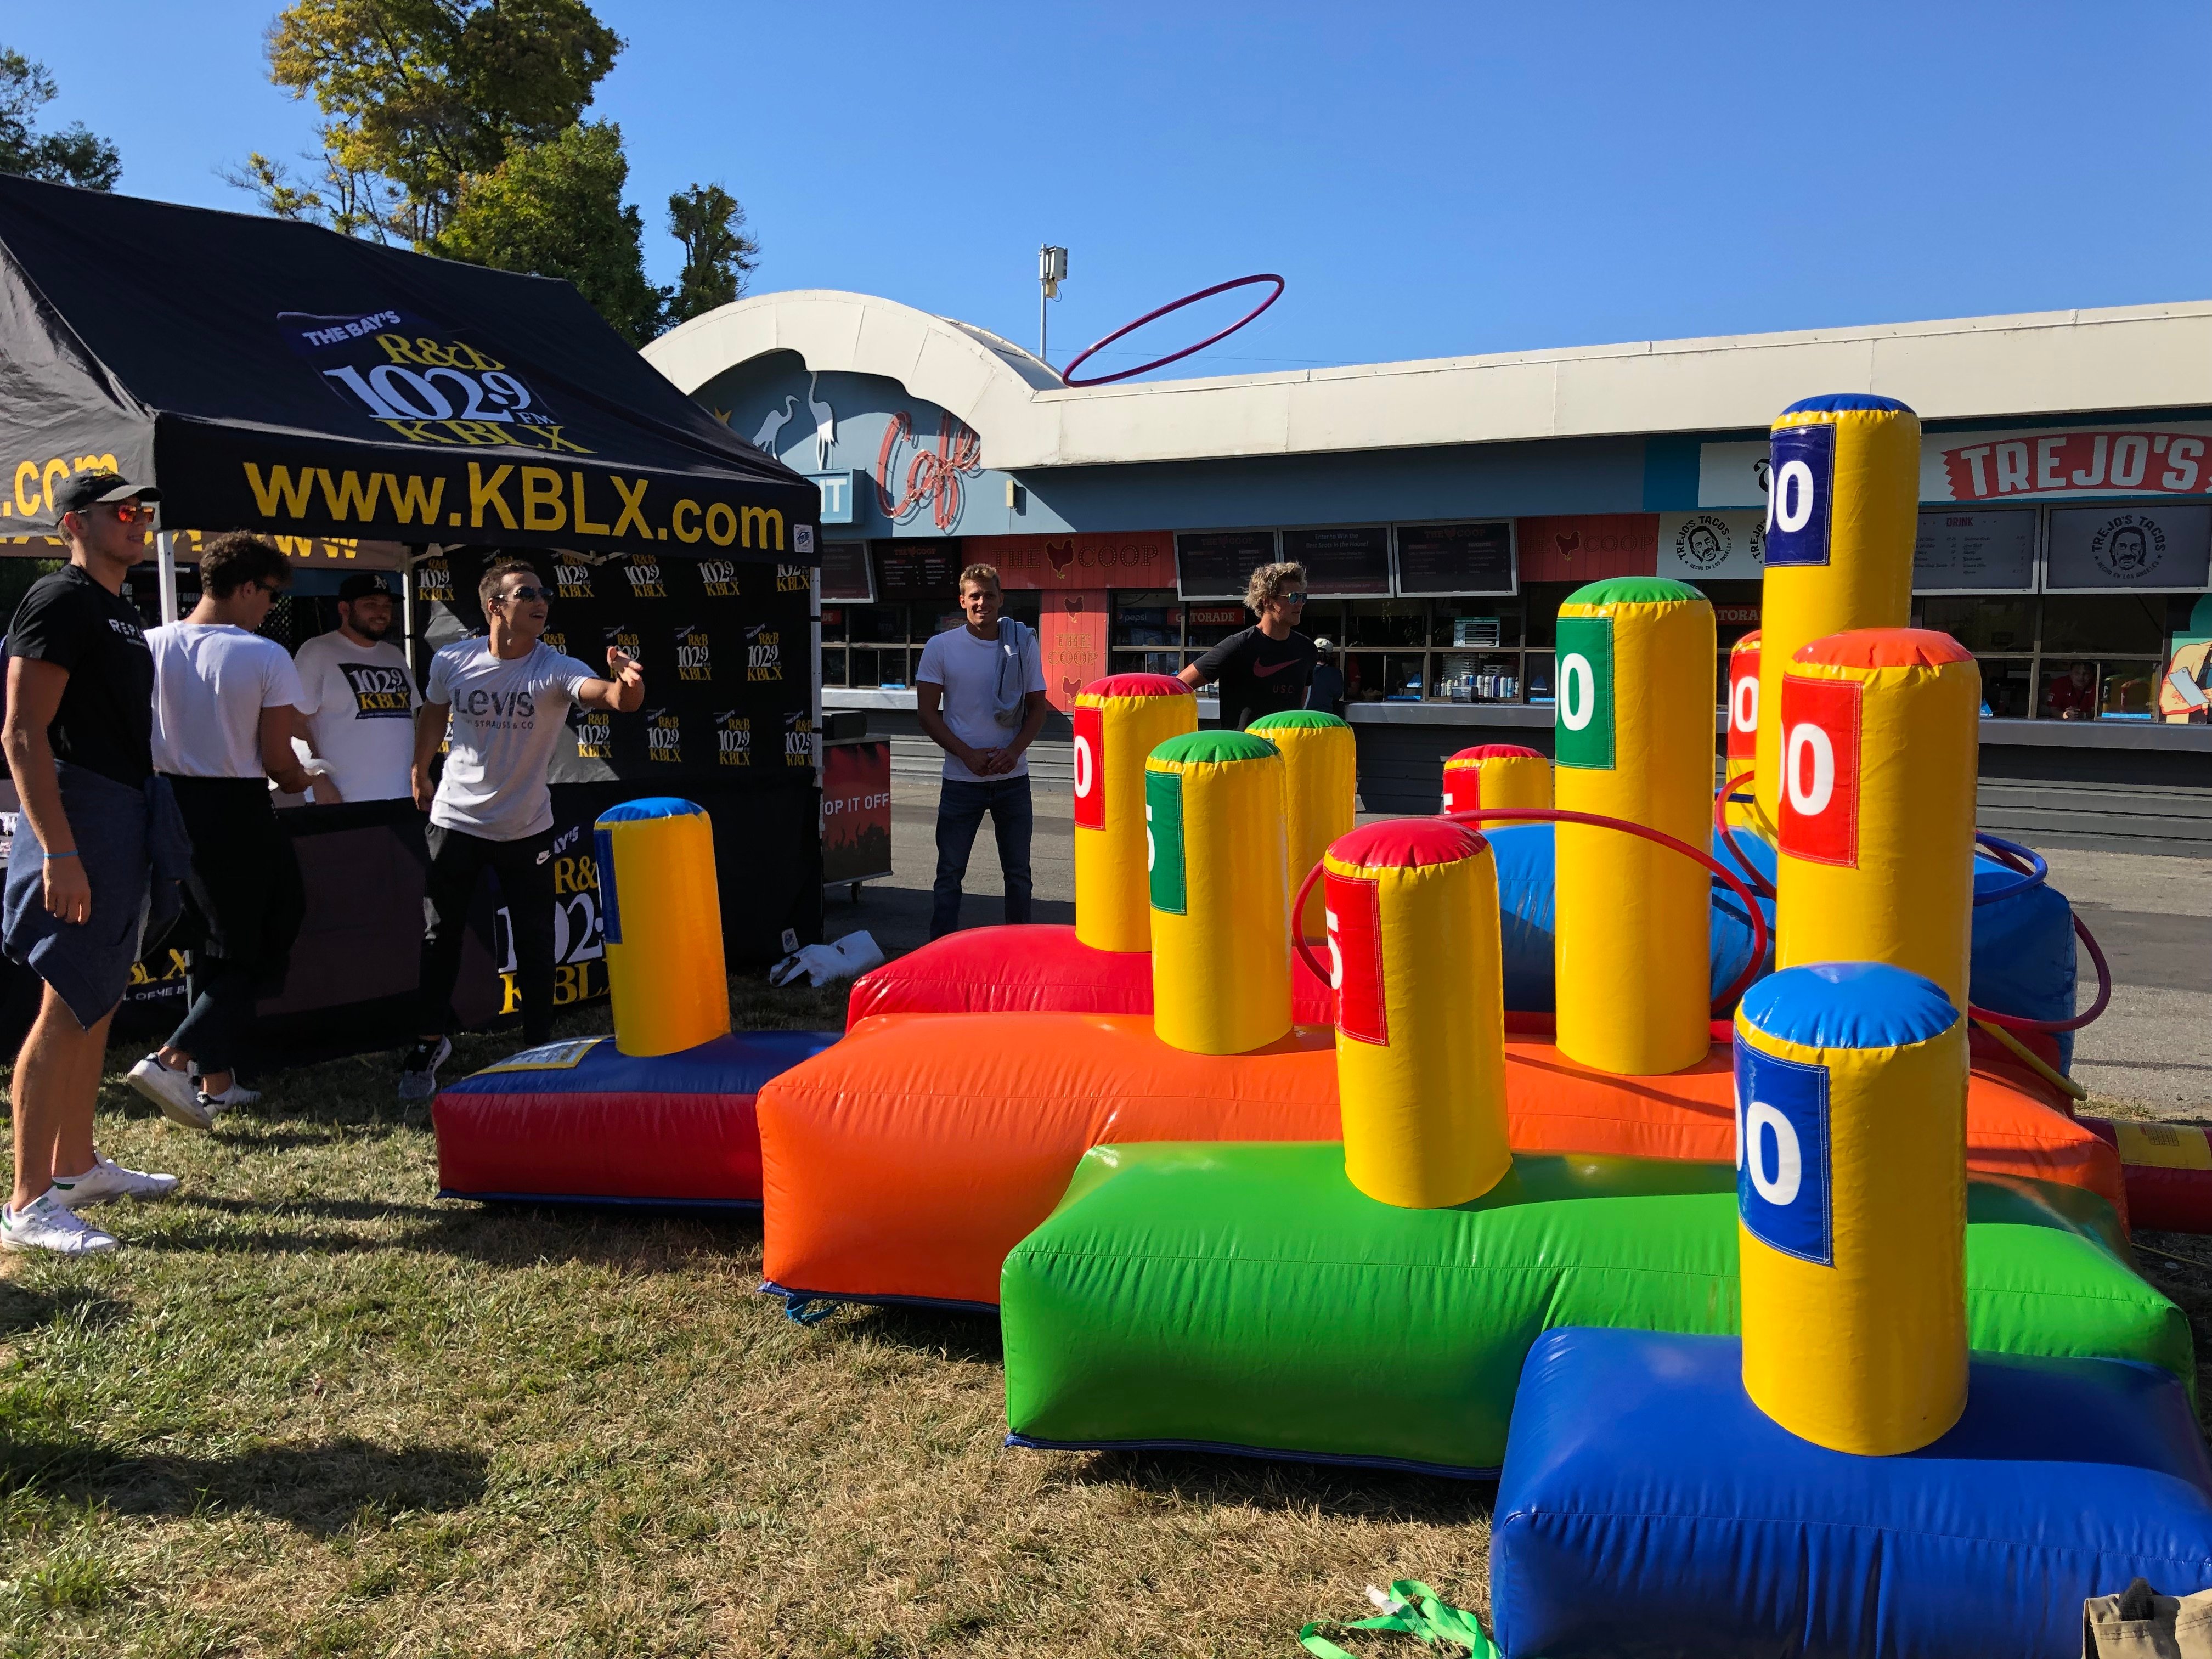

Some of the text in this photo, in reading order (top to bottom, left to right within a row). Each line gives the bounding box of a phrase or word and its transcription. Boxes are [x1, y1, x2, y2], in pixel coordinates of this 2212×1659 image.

[302, 310, 401, 346] THE BAY'S
[516, 411, 557, 425] FM
[376, 419, 599, 454] KBLX
[1961, 435, 2205, 496] TREJO'S
[242, 462, 784, 550] www.KBLX.com
[1946, 517, 1974, 527] DRINK
[1676, 516, 1730, 560] TREJO'S TACOS
[1750, 519, 1766, 560] TREJO'
[2092, 515, 2166, 552] TREJO'S TACOS
[1518, 534, 1654, 554] HE COOP
[991, 544, 1158, 569] THE COOP
[558, 584, 595, 597] KBLX
[631, 584, 668, 597] KBLX
[704, 582, 740, 596] KBLX
[777, 574, 810, 592] KBLX
[1125, 612, 1147, 623] pepsi
[1175, 612, 1235, 624] GTORADE
[1717, 610, 1760, 621] TORA
[544, 633, 566, 645] R&B
[617, 633, 639, 646] R&B
[688, 633, 708, 646] R&B
[758, 631, 780, 645] R&B
[1056, 634, 1091, 648] THE
[1048, 650, 1098, 665] COOP
[679, 667, 713, 681] KBLX
[747, 666, 783, 681] KBLX
[1555, 653, 1594, 731] 0
[359, 692, 410, 710] KBLX
[1728, 676, 1759, 732] 0
[475, 720, 510, 729] STRAUSS
[588, 713, 610, 725] R&B
[658, 715, 680, 729] R&B
[728, 718, 751, 731] R&B
[578, 744, 613, 758] KBLX
[650, 748, 682, 763] KBLX
[719, 751, 751, 766] KBLX
[1779, 721, 1835, 816] 0
[823, 793, 889, 816] OP IT OFF
[554, 826, 579, 854] AY'S
[555, 855, 599, 894] R&
[498, 960, 613, 1015] KBL
